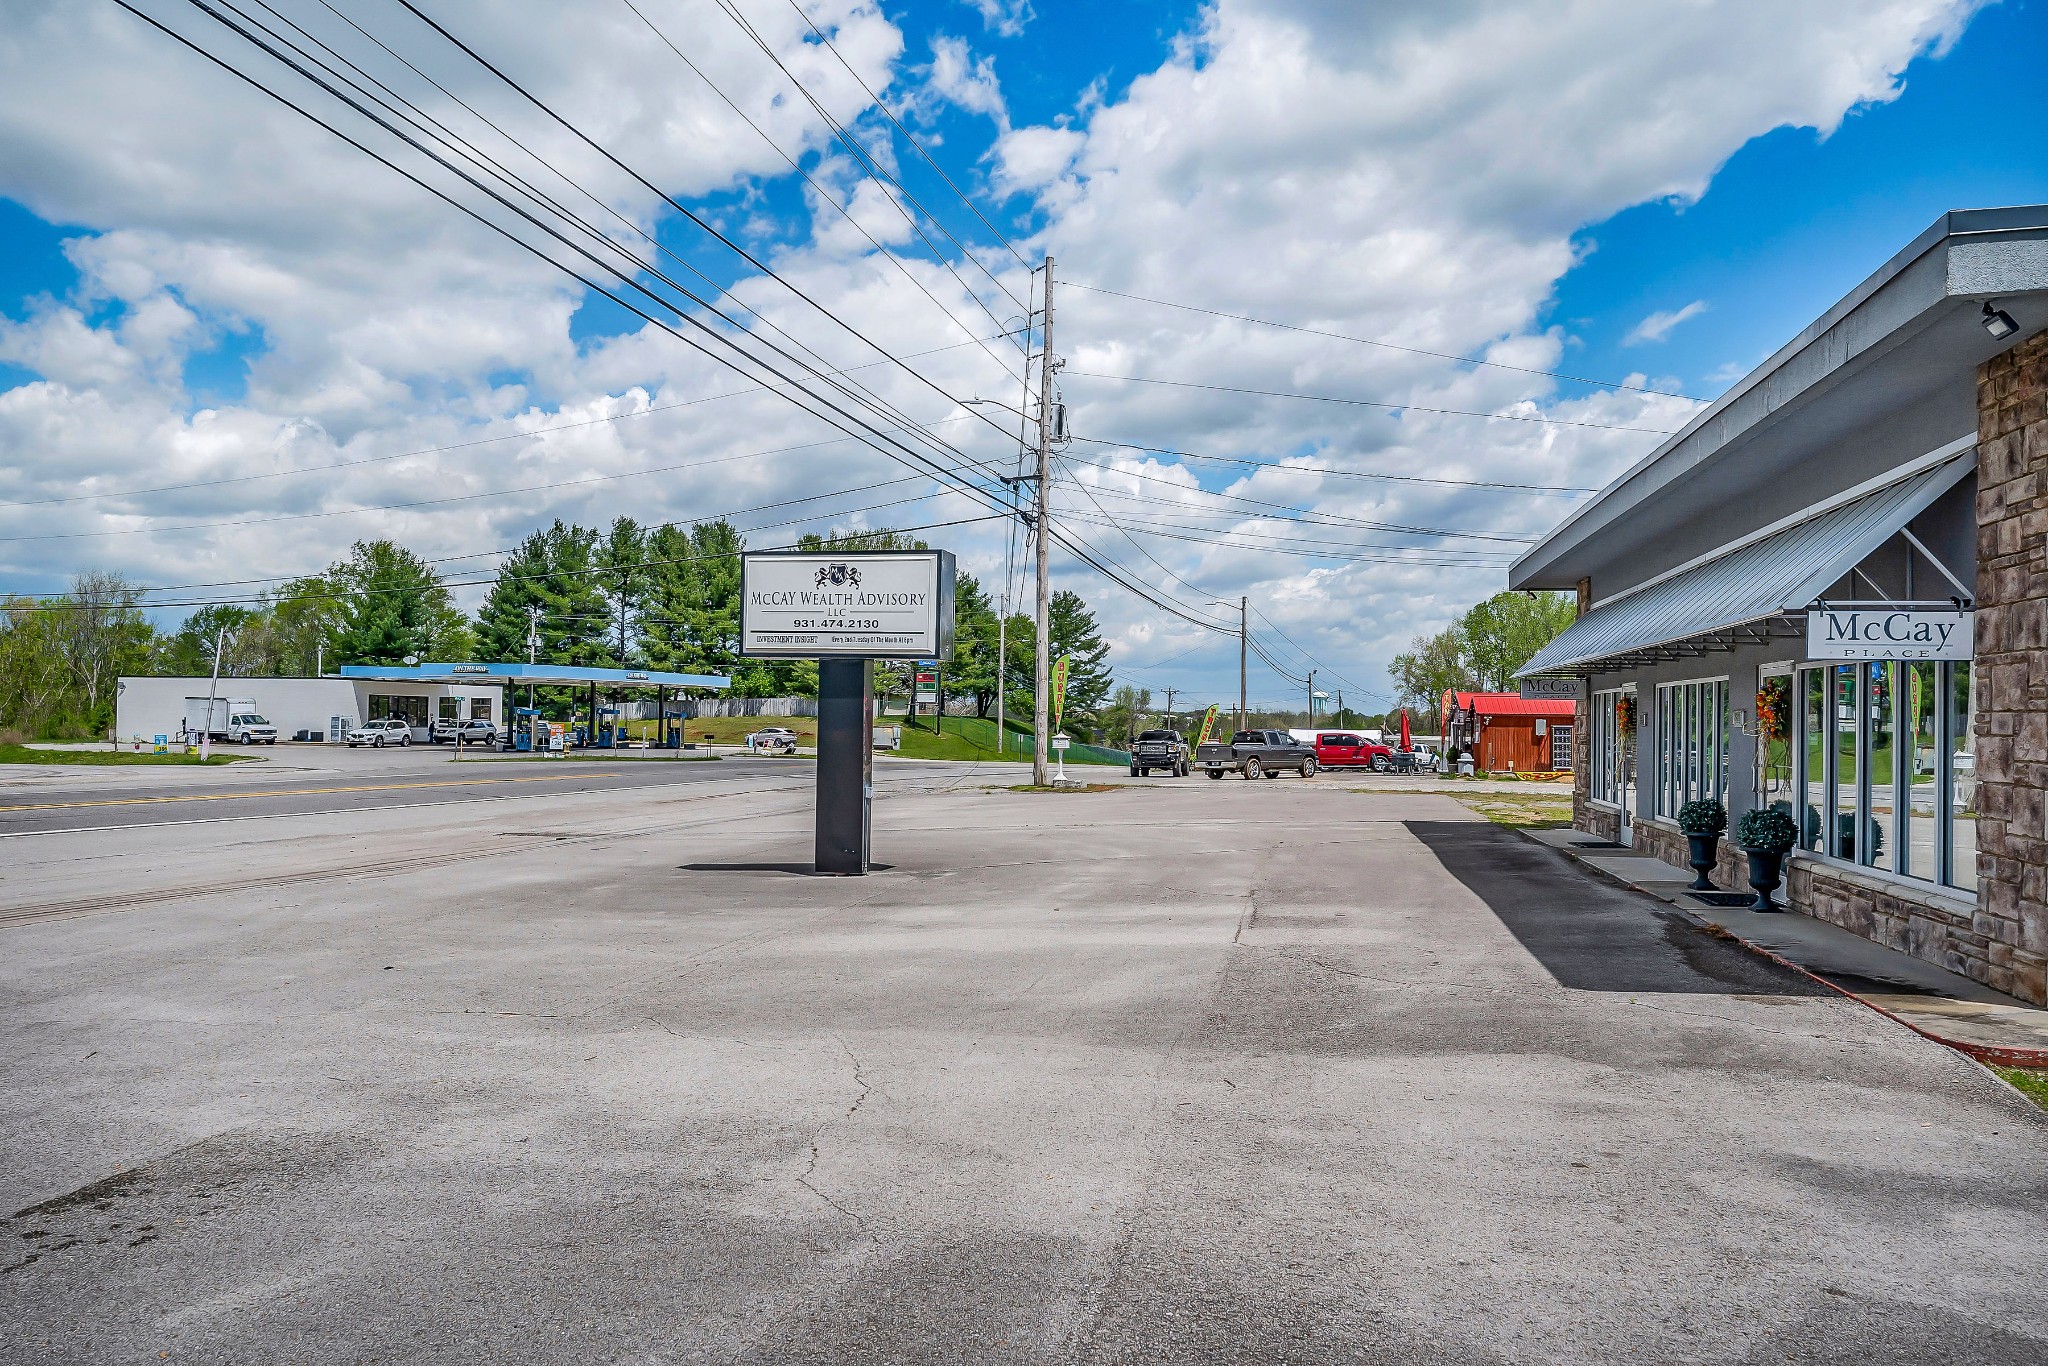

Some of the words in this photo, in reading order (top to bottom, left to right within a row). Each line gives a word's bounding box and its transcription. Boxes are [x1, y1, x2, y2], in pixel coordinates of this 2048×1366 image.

[800, 591, 853, 606] WEALTH
[857, 591, 926, 606] ADVISORY
[828, 607, 847, 617] LLC
[793, 619, 879, 629] 931.474.2130
[1825, 613, 1956, 652] McCay
[756, 635, 793, 643] INVESTMENT
[1844, 649, 1930, 658] PLACE
[1527, 679, 1579, 697] McCay
